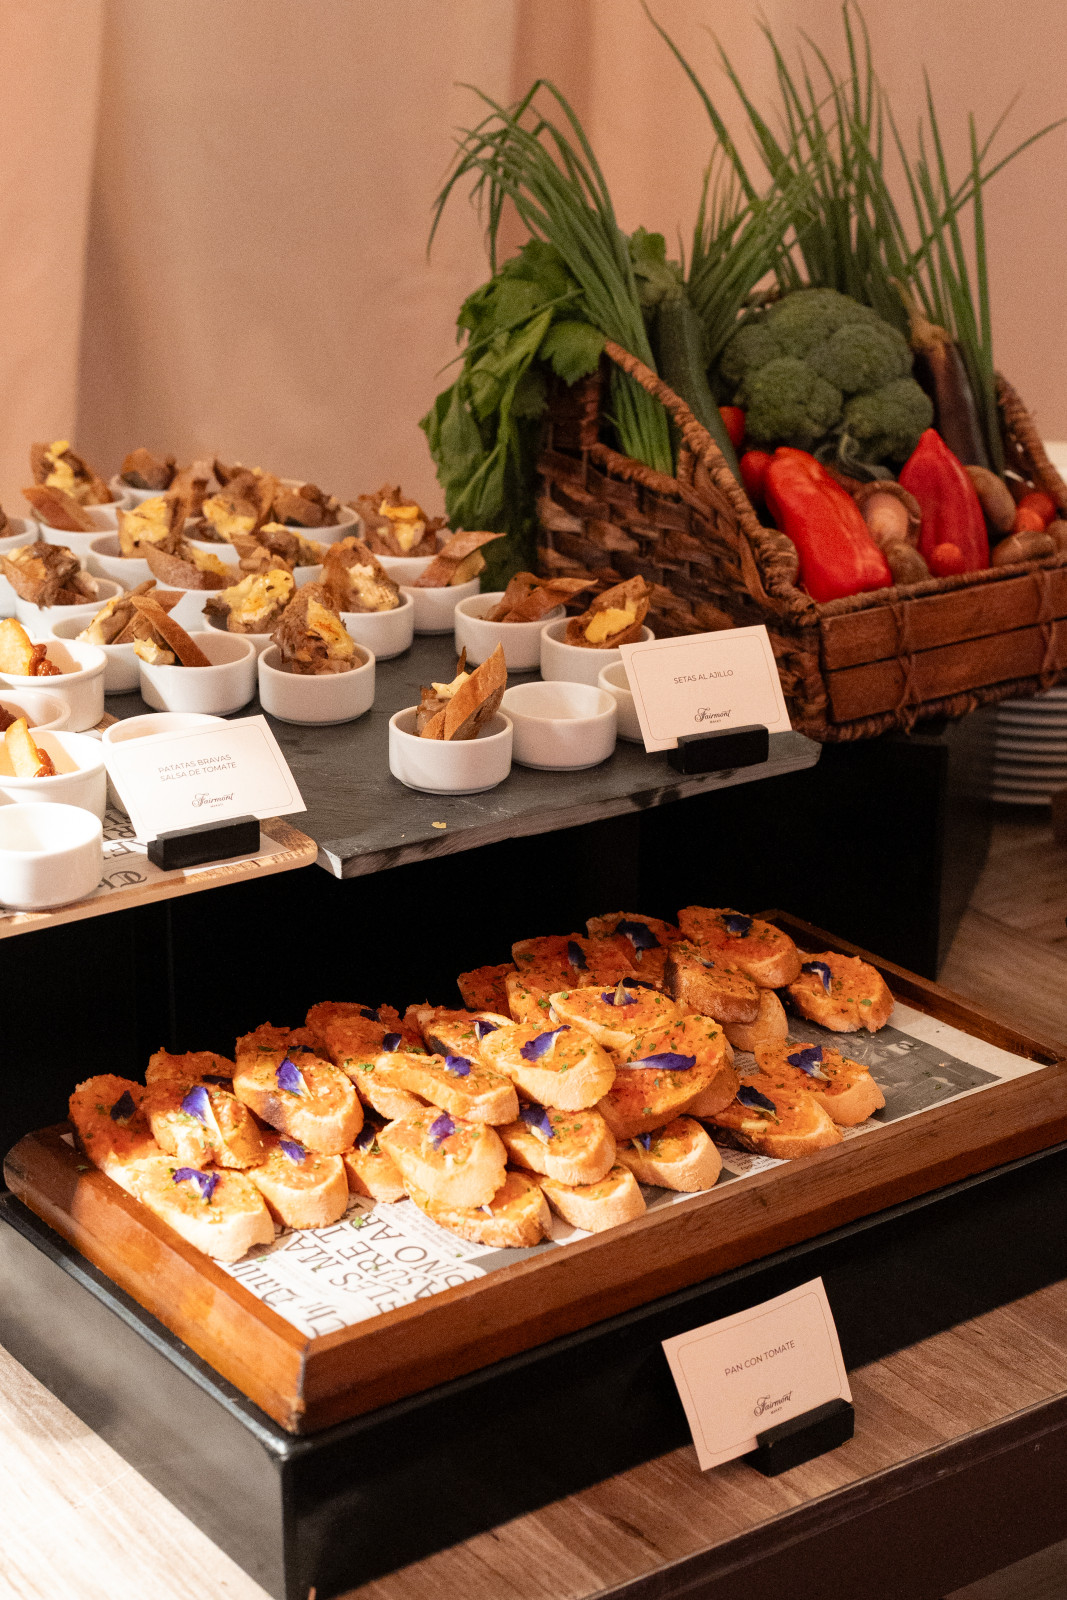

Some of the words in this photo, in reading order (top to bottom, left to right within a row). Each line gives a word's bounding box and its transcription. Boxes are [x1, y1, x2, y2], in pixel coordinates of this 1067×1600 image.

[673, 675, 697, 684] SETAS
[698, 673, 708, 681] AL
[709, 669, 734, 679] AJILLO
[694, 707, 732, 722] Fairmont
[158, 760, 197, 773] PATATAS
[197, 754, 232, 766] BRAVAS
[160, 771, 187, 781] SALSA
[188, 768, 201, 777] DE
[202, 761, 237, 773] TOMATE
[191, 792, 234, 808] Fairmont
[724, 1363, 743, 1376] PAN
[744, 1354, 763, 1368] CON
[764, 1339, 796, 1360] TOMATE
[753, 1390, 793, 1417] Fairmont
